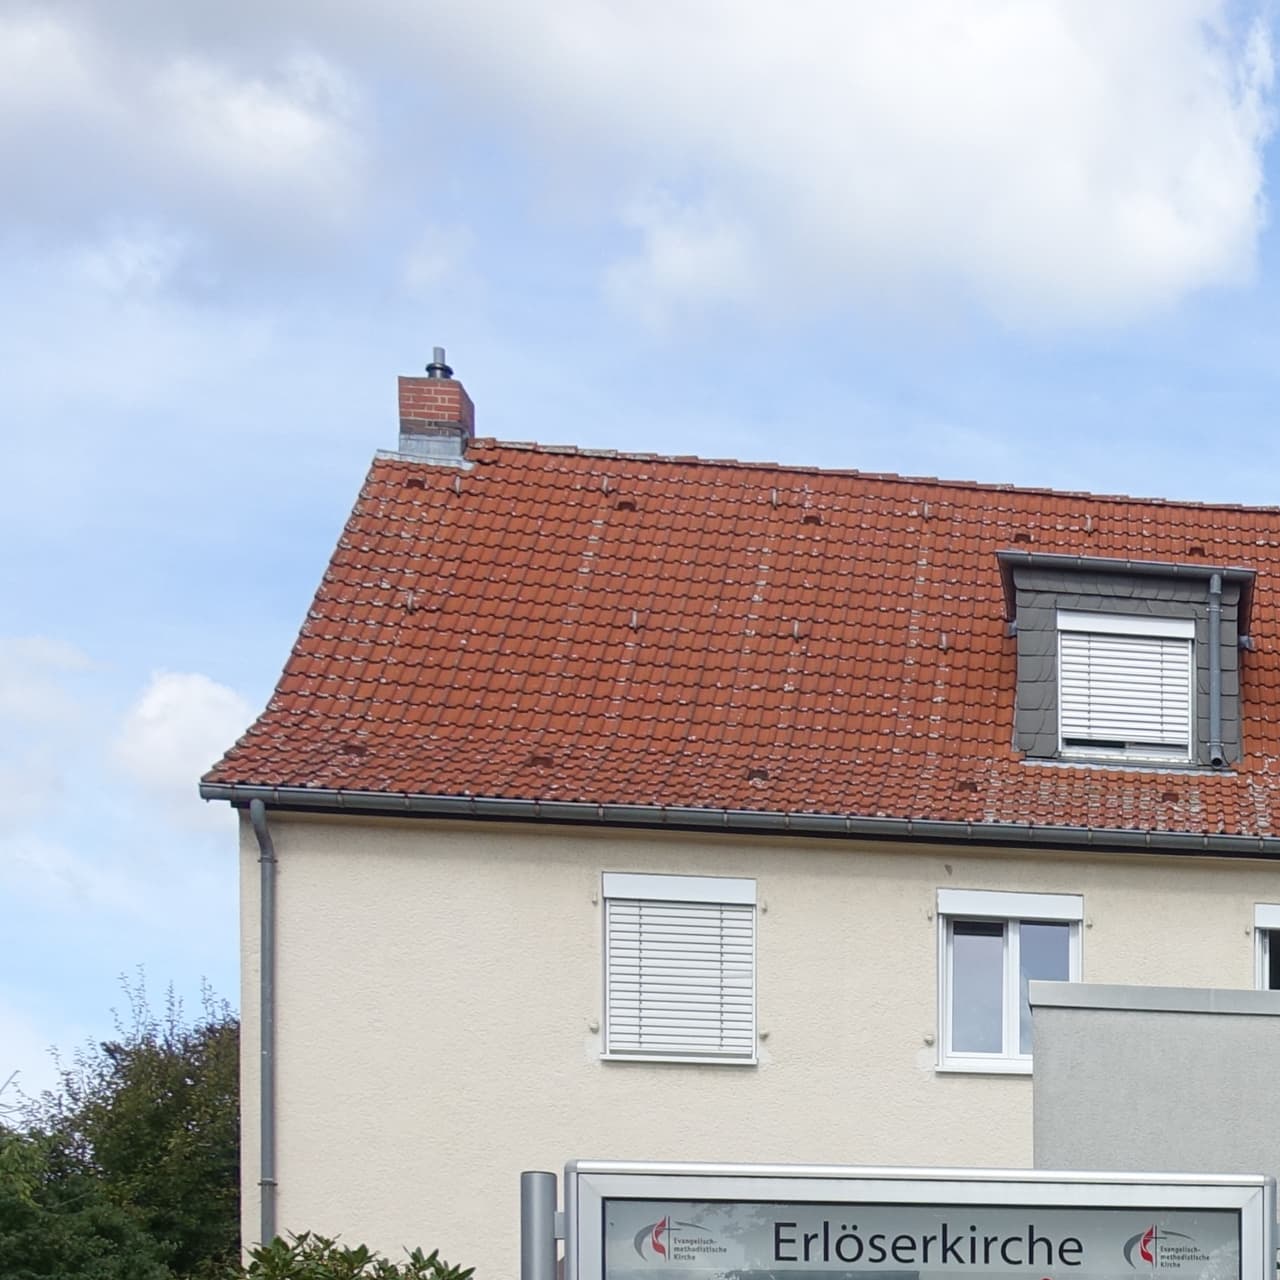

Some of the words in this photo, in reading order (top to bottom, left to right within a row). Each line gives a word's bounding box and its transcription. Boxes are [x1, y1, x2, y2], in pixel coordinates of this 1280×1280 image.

[673, 1236, 718, 1246] Evangelisch-
[773, 1220, 1083, 1266] Erlöserkirche
[673, 1245, 727, 1253] methodistische
[1159, 1245, 1201, 1255] Evangelisch-
[673, 1253, 696, 1261] Kirche
[1159, 1252, 1210, 1261] methodistische
[1159, 1260, 1181, 1268] Kirche
